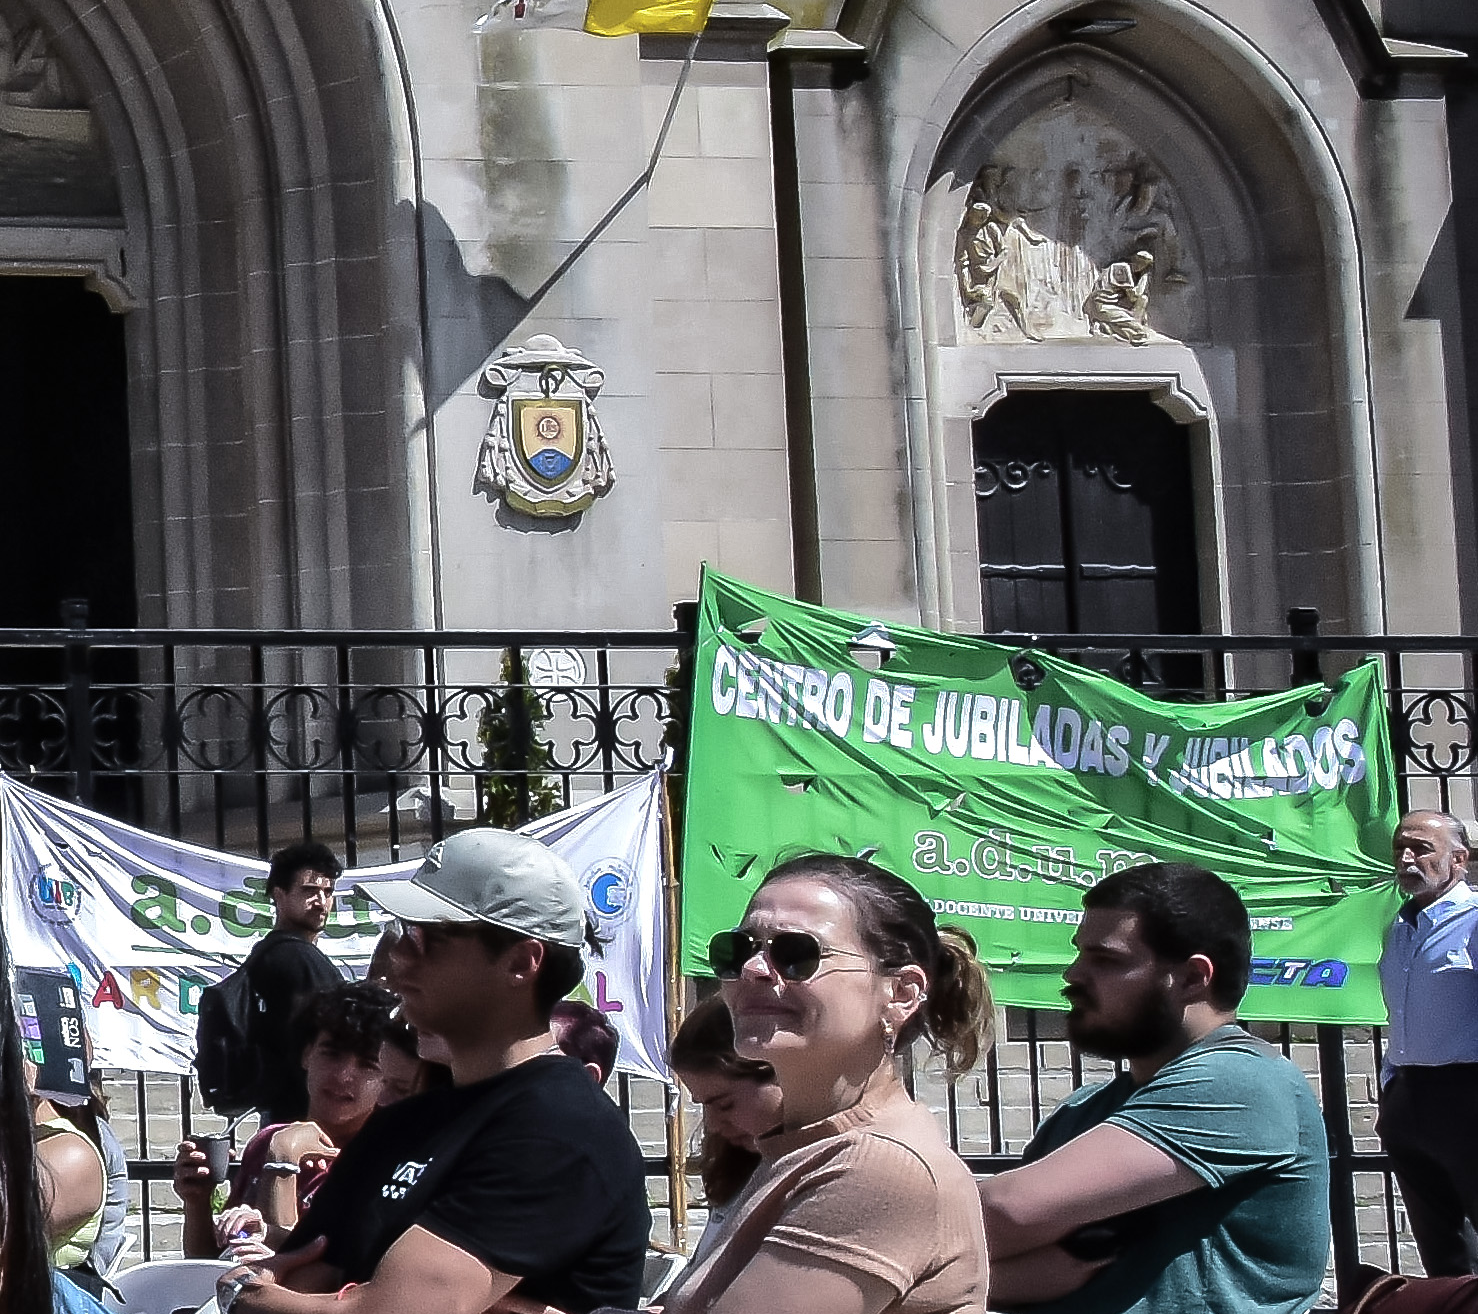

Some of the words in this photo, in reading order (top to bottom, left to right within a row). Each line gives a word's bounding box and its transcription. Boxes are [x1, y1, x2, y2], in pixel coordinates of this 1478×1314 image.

[712, 644, 854, 738] CENTRO
[863, 678, 916, 749] DE
[922, 690, 1130, 777] JUBILADAS
[1143, 733, 1170, 785] Y
[1168, 718, 1366, 799] JUBILADOS
[933, 899, 1015, 920] DOCENTE
